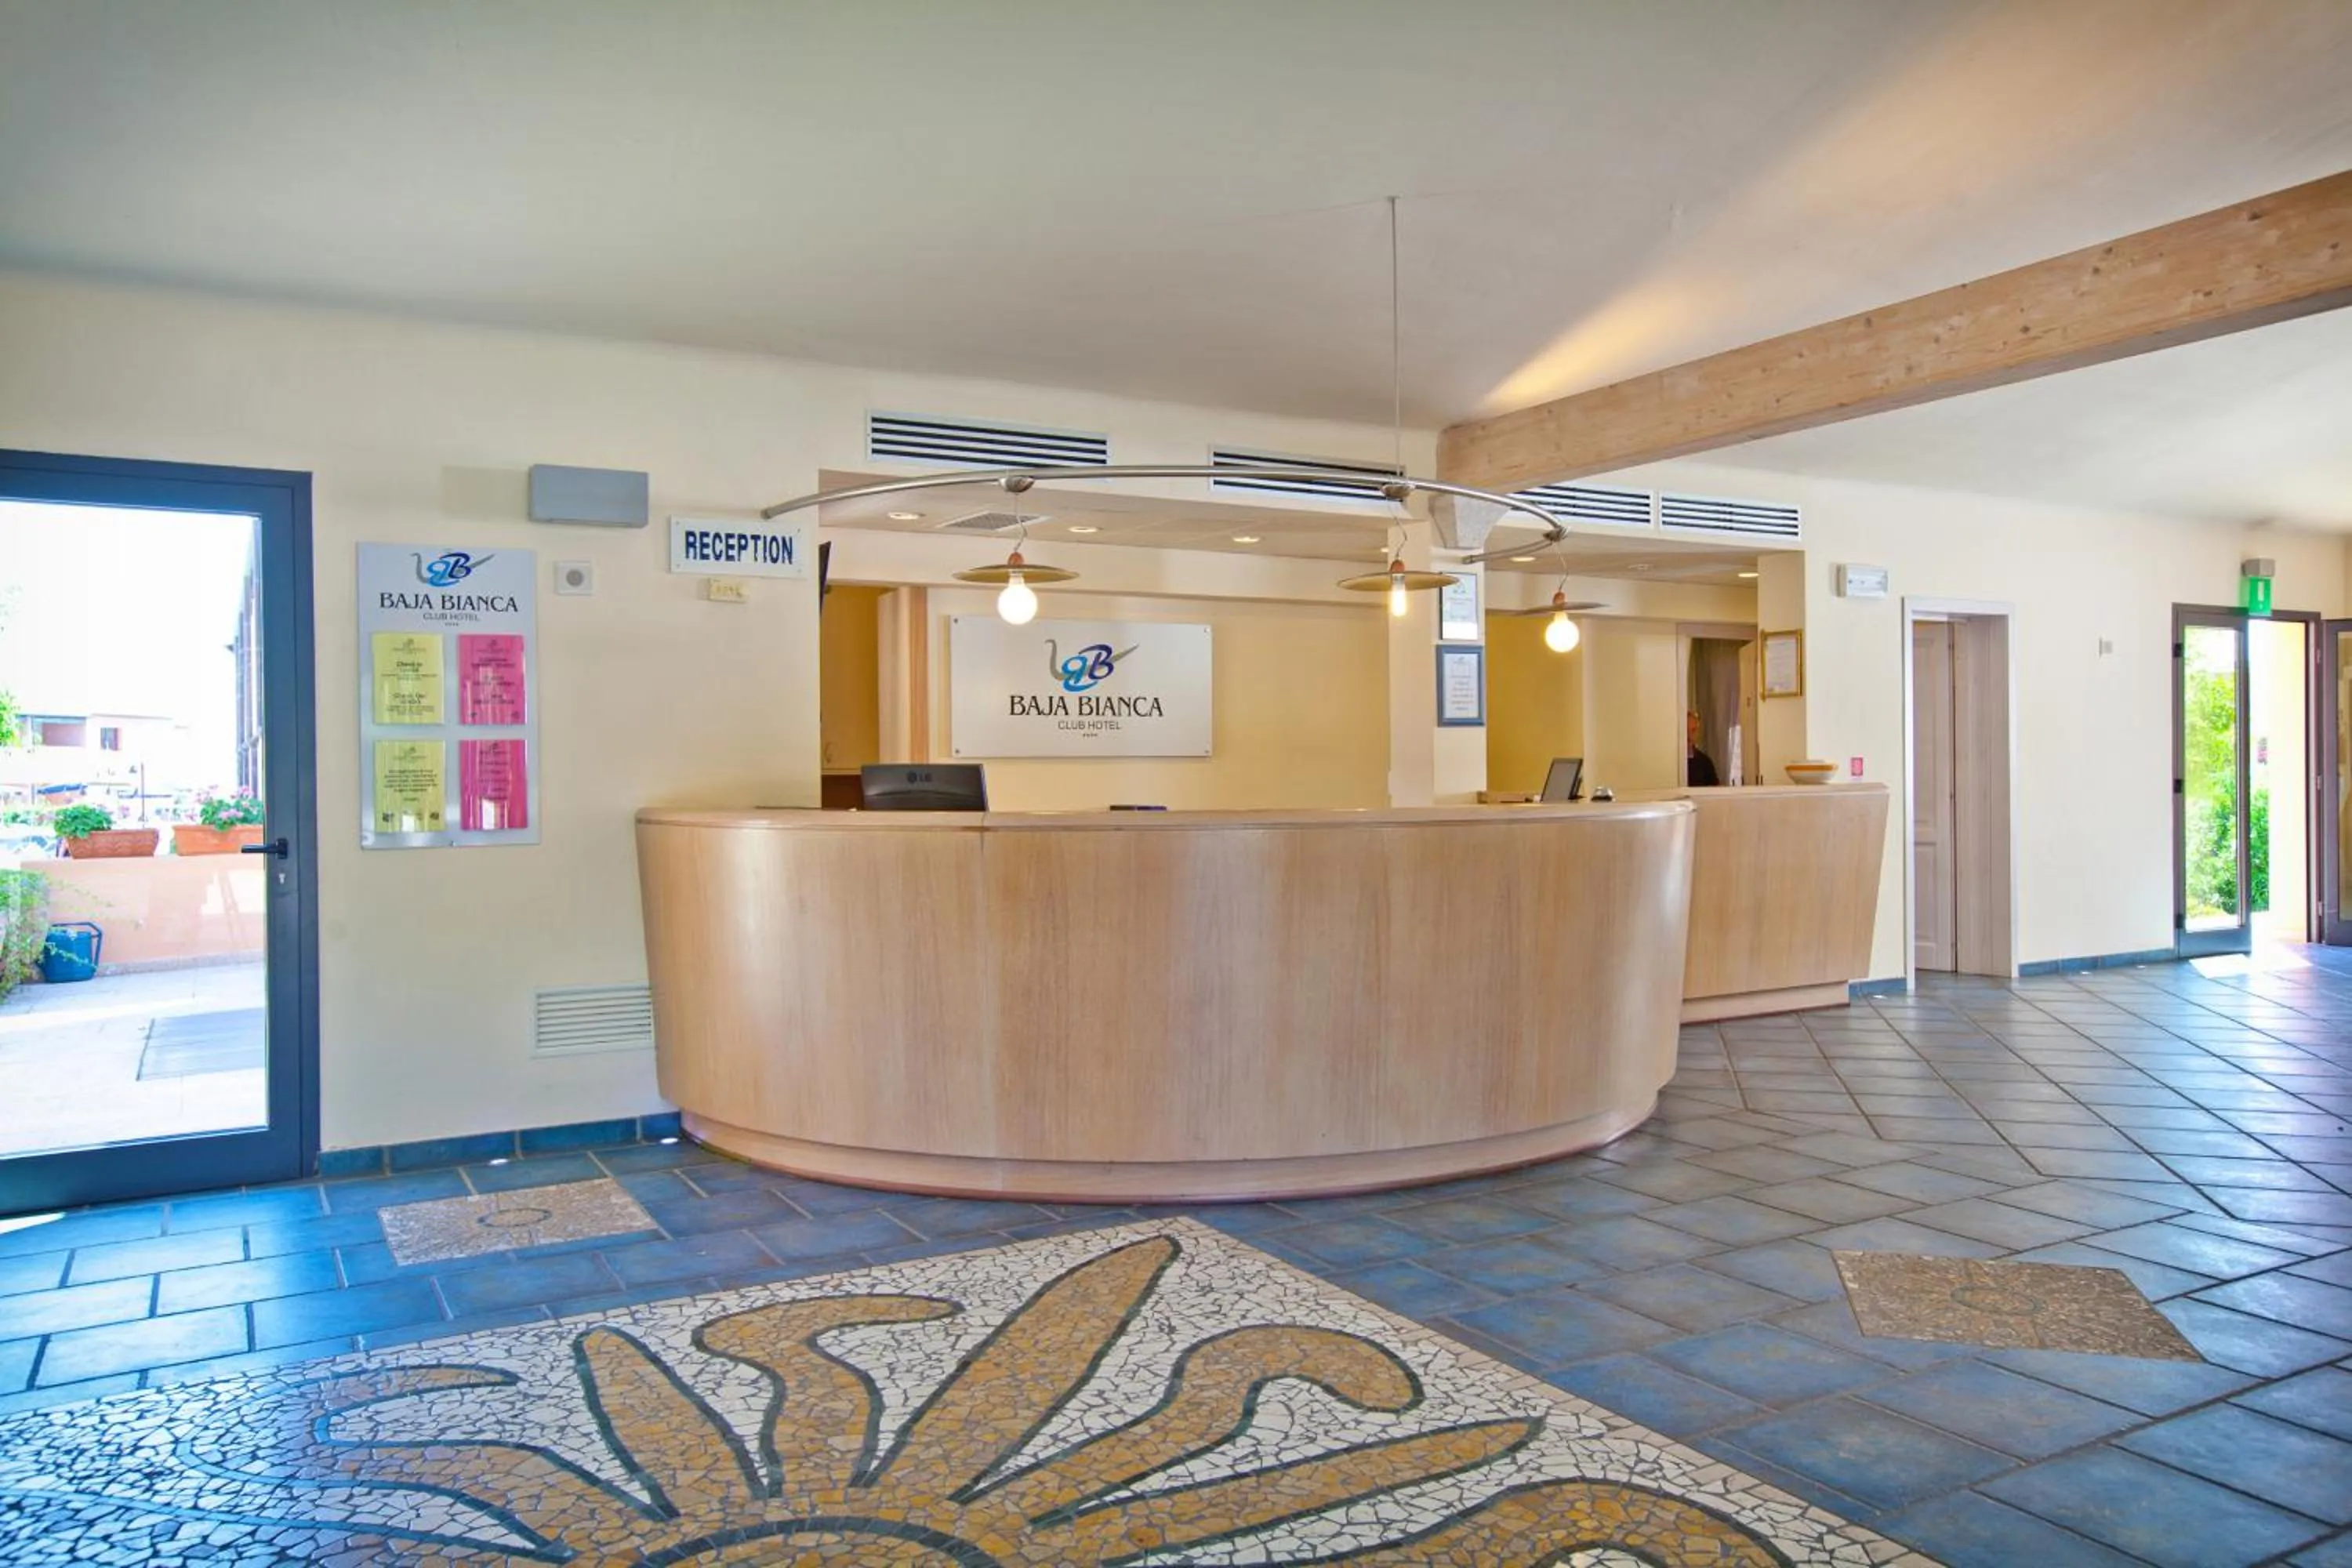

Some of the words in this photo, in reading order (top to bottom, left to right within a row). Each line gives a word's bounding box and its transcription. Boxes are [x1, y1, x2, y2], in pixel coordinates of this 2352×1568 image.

[685, 531, 793, 564] RECEPTION
[379, 592, 434, 609] BAJA
[441, 594, 518, 612] BIANCA
[450, 612, 480, 622] HOTEL
[1009, 695, 1069, 717] BAJA
[1078, 695, 1163, 717] BIANCA
[1058, 720, 1086, 730] CLUB
[1087, 720, 1121, 730] HOTEL
